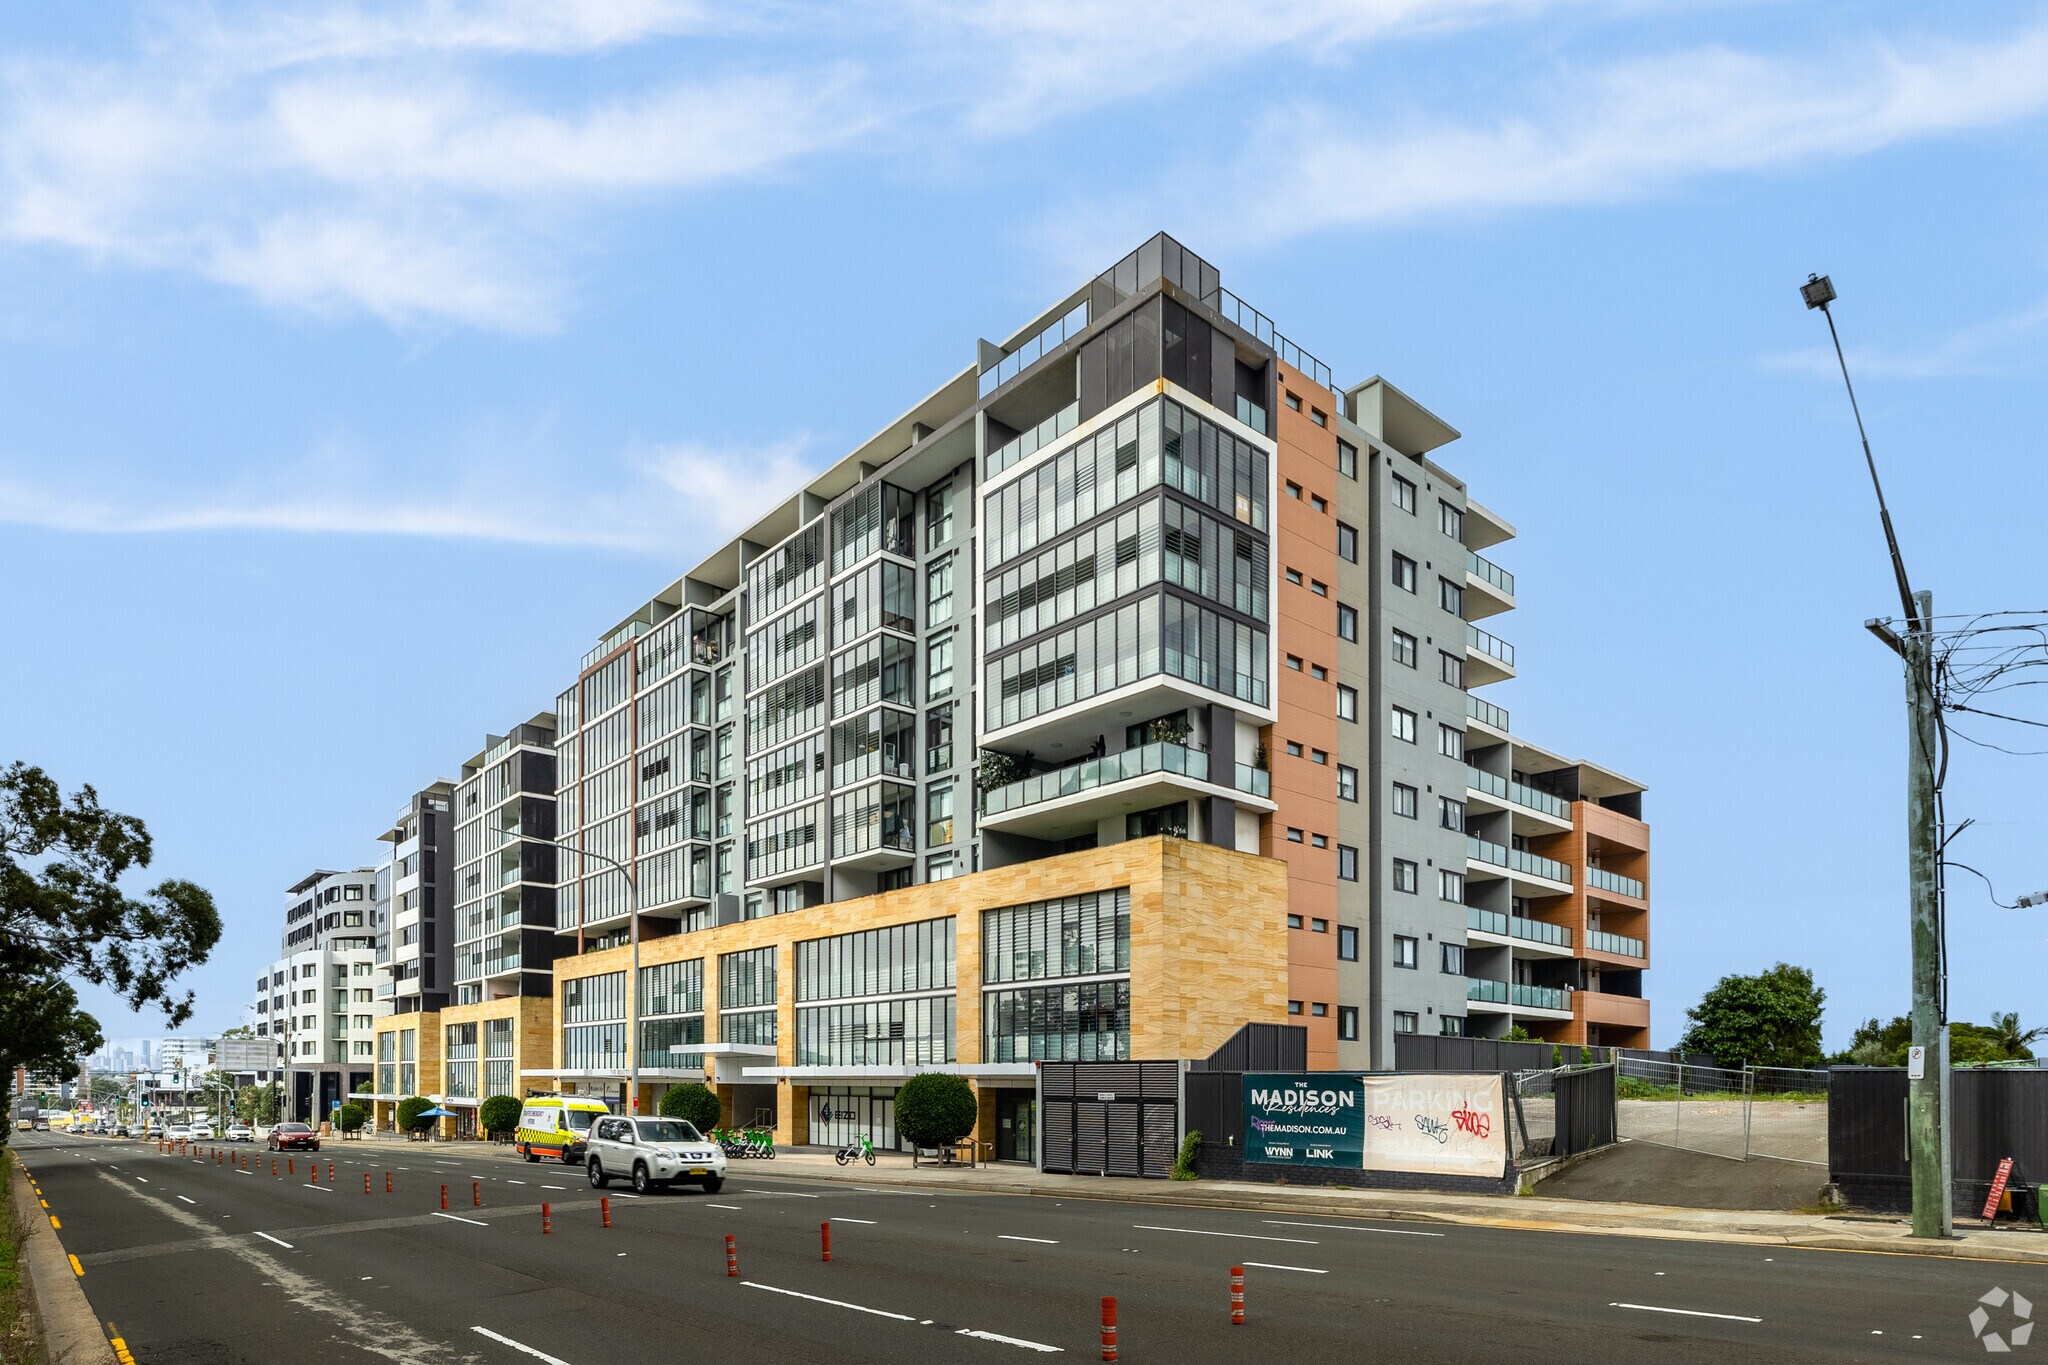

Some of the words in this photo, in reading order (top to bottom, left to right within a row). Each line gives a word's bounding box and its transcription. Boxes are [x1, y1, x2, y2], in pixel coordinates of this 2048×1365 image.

[1251, 1089, 1354, 1107] MADISON
[1373, 1089, 1494, 1112] PARKING
[1262, 1098, 1340, 1117] Residences
[1260, 1124, 1347, 1135] THEMADISON.COM.AU
[1264, 1146, 1293, 1157] WYNN
[1306, 1148, 1334, 1159] LINK
